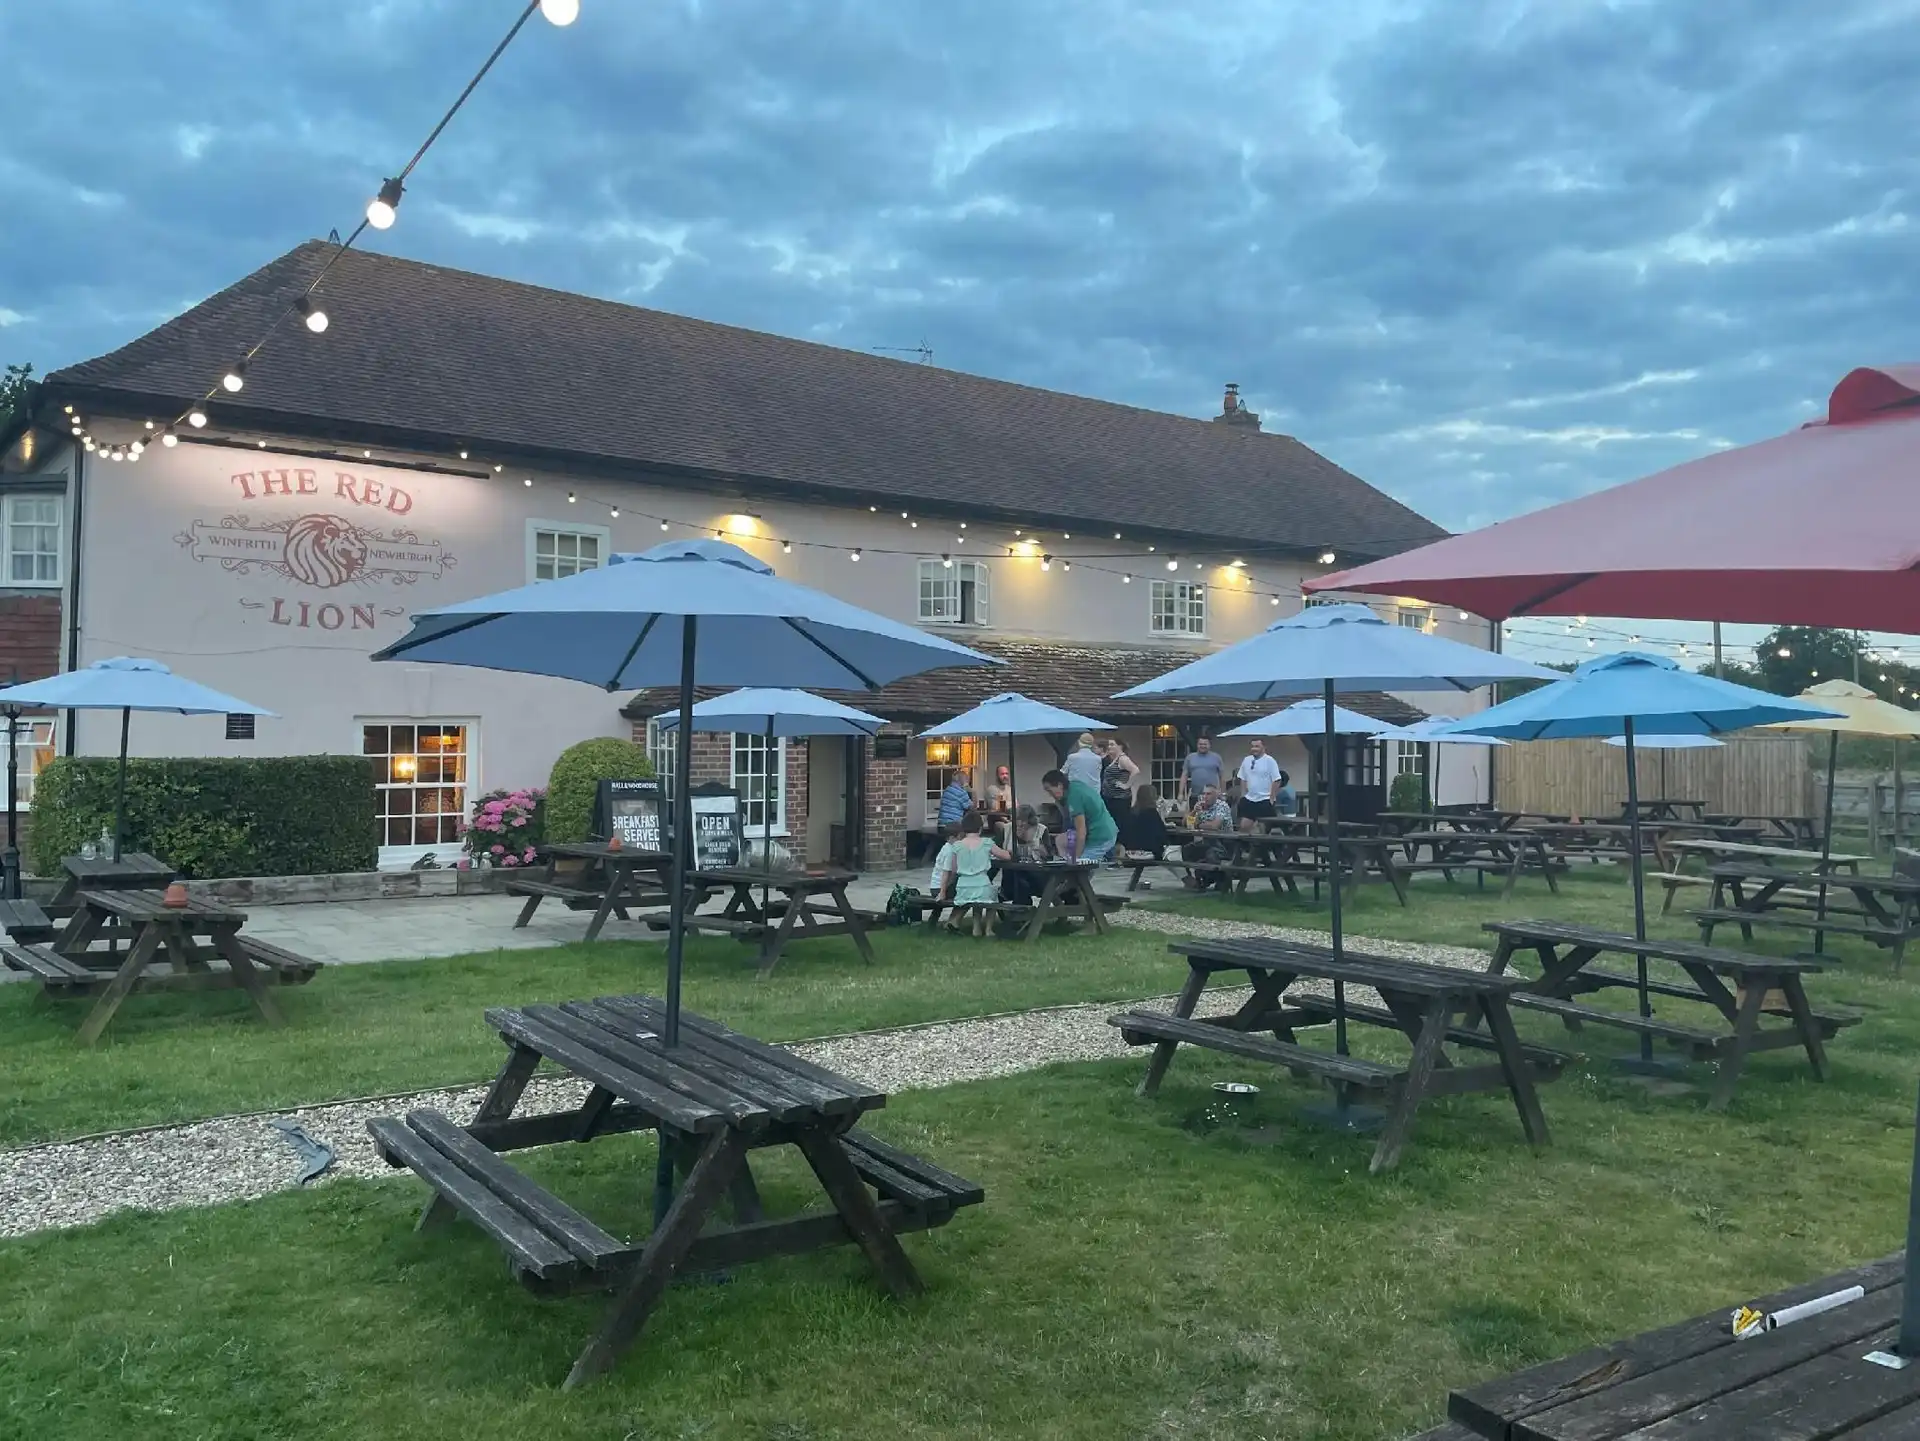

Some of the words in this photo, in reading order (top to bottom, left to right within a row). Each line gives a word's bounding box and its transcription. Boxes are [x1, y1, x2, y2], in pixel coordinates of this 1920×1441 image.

[231, 468, 319, 500] THE
[334, 471, 413, 516] RED
[208, 535, 277, 551] WINFRITH
[369, 548, 433, 563] NEWBURGH
[269, 596, 376, 631] LION
[612, 815, 660, 829] BREAKFAST
[701, 816, 730, 830] OPEN
[624, 828, 660, 842] SERVED
